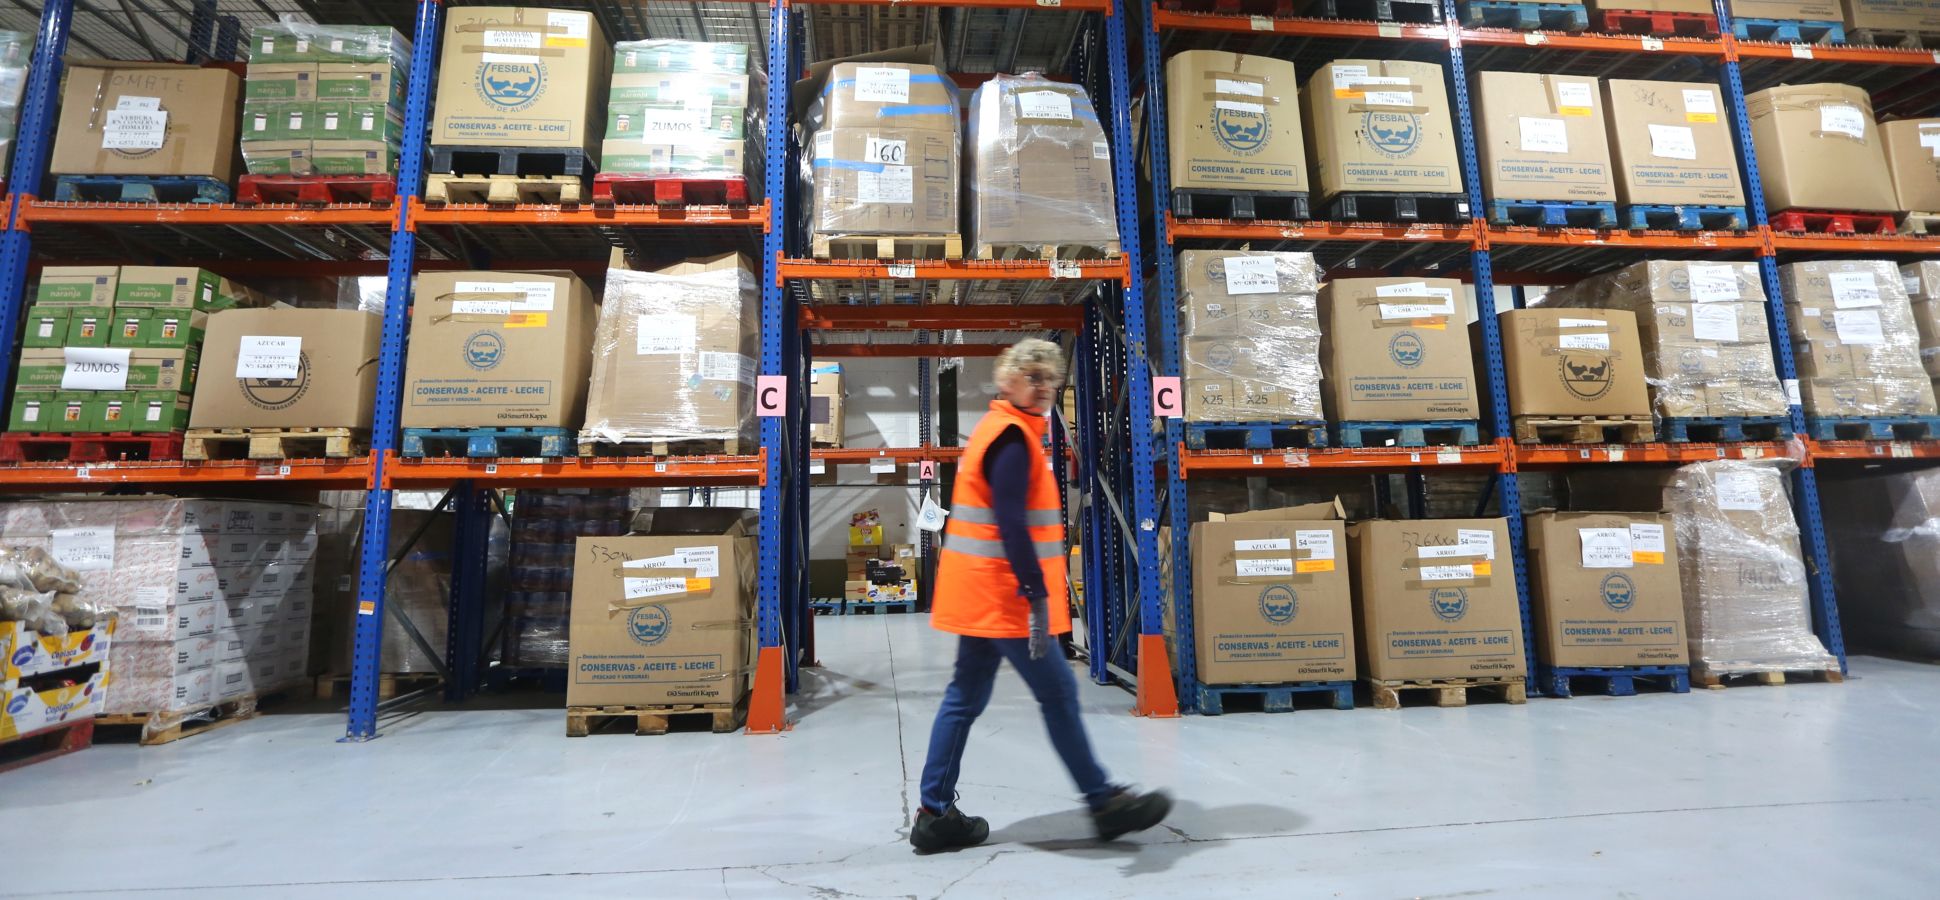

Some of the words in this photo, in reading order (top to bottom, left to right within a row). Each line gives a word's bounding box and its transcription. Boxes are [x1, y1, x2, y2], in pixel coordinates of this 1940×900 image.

[492, 65, 532, 74] FESBAL
[475, 83, 496, 108] BANCOS
[510, 84, 548, 112] ALIMENTOS
[1223, 109, 1258, 118] FESBAL
[1374, 114, 1408, 122] FESBAL
[448, 122, 497, 131] CONSERVAS
[503, 124, 533, 132] ACEITE
[539, 125, 565, 133] LECHE
[652, 122, 692, 132] ZUMOS
[1210, 127, 1231, 152] BANCOS
[873, 142, 902, 162] 160
[1808, 277, 1825, 286] X25
[1207, 309, 1228, 319] X25
[1248, 309, 1270, 320] X25
[1667, 317, 1686, 327] X25
[1825, 354, 1843, 363] X25
[74, 362, 120, 373] ZUMOS
[760, 386, 778, 410] C
[1158, 388, 1174, 410] C
[1202, 394, 1224, 405] X25
[1246, 394, 1268, 404] X25
[924, 466, 932, 476] A
[1218, 642, 1269, 650] CONSERVAS
[1276, 641, 1306, 649] ACEITE
[1312, 640, 1339, 648] LECHE
[1392, 639, 1442, 647] CONSERVAS
[581, 664, 636, 672] CONSERVAS
[643, 662, 676, 671] ACEITE
[684, 662, 715, 670] LECHE
[45, 702, 74, 715] Coplaca
